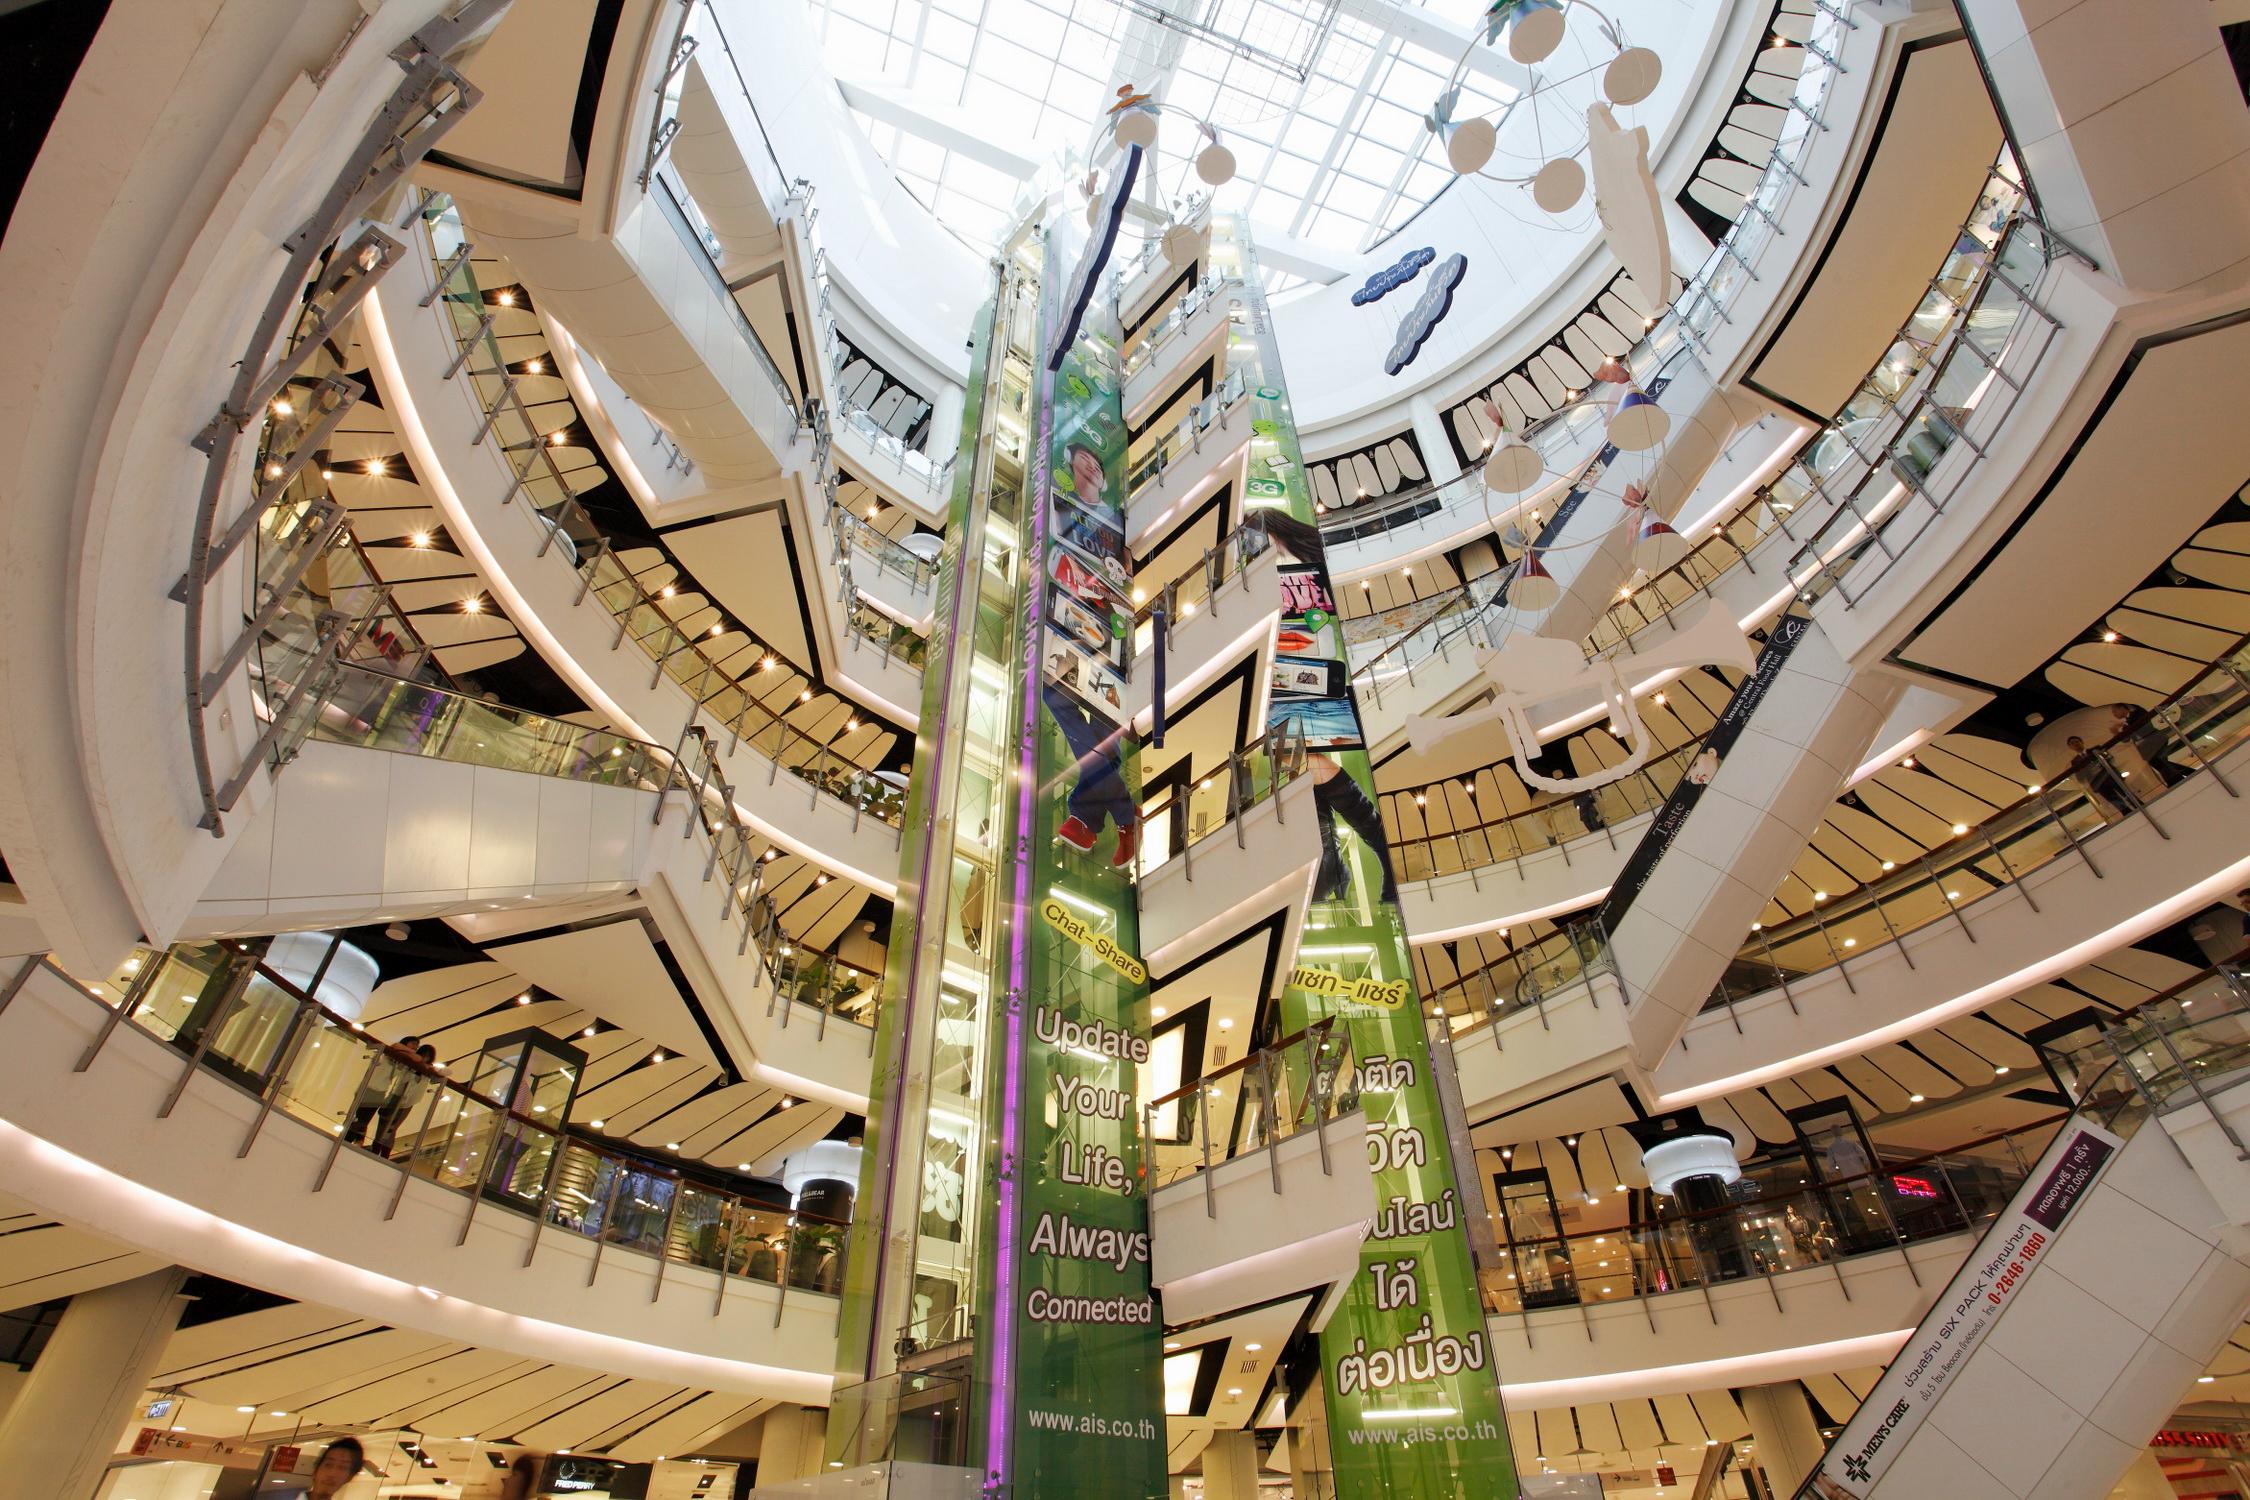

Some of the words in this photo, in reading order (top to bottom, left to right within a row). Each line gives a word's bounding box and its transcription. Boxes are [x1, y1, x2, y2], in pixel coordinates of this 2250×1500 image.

[1027, 477, 1045, 530] Your
[1249, 481, 1279, 495] 3G
[1557, 499, 1577, 518] See
[1018, 619, 1038, 686] Your
[1723, 698, 1744, 725] Amaze
[1741, 680, 1755, 699] your
[1743, 684, 1762, 710] Central
[1759, 667, 1773, 686] Food
[1769, 653, 1782, 671] Hall
[1652, 802, 1686, 838] Taste
[1636, 877, 1647, 891] the
[1645, 857, 1660, 877] taste
[1035, 1006, 1149, 1063] Update
[1055, 1072, 1132, 1120] Your
[1061, 1140, 1134, 1197] Life,
[2036, 1170, 2072, 1214] ทดลองฟรี
[2065, 1162, 2077, 1171] 1
[1028, 1211, 1148, 1272] Always
[1027, 1289, 1153, 1324] Connected
[1369, 1257, 1418, 1311] ได้
[1904, 1340, 1942, 1389] ช่วยสร้าง
[1940, 1316, 1960, 1340] SIX
[1956, 1279, 1988, 1317] PACK
[1980, 1223, 2032, 1280] ให้คุณง่ายๆ
[1927, 1382, 1937, 1392] 5
[1941, 1348, 1963, 1373] Beacon
[1987, 1231, 2047, 1305] 0-2646-1860
[1337, 1313, 1486, 1397] ต่อเนื่อง
[1029, 1409, 1156, 1441] www.ais.co.th
[1348, 1419, 1498, 1445] www.ais.co.th
[1885, 1398, 1911, 1429] CARE
[555, 1480, 573, 1488] FRED
[572, 1481, 595, 1489] PERRY
